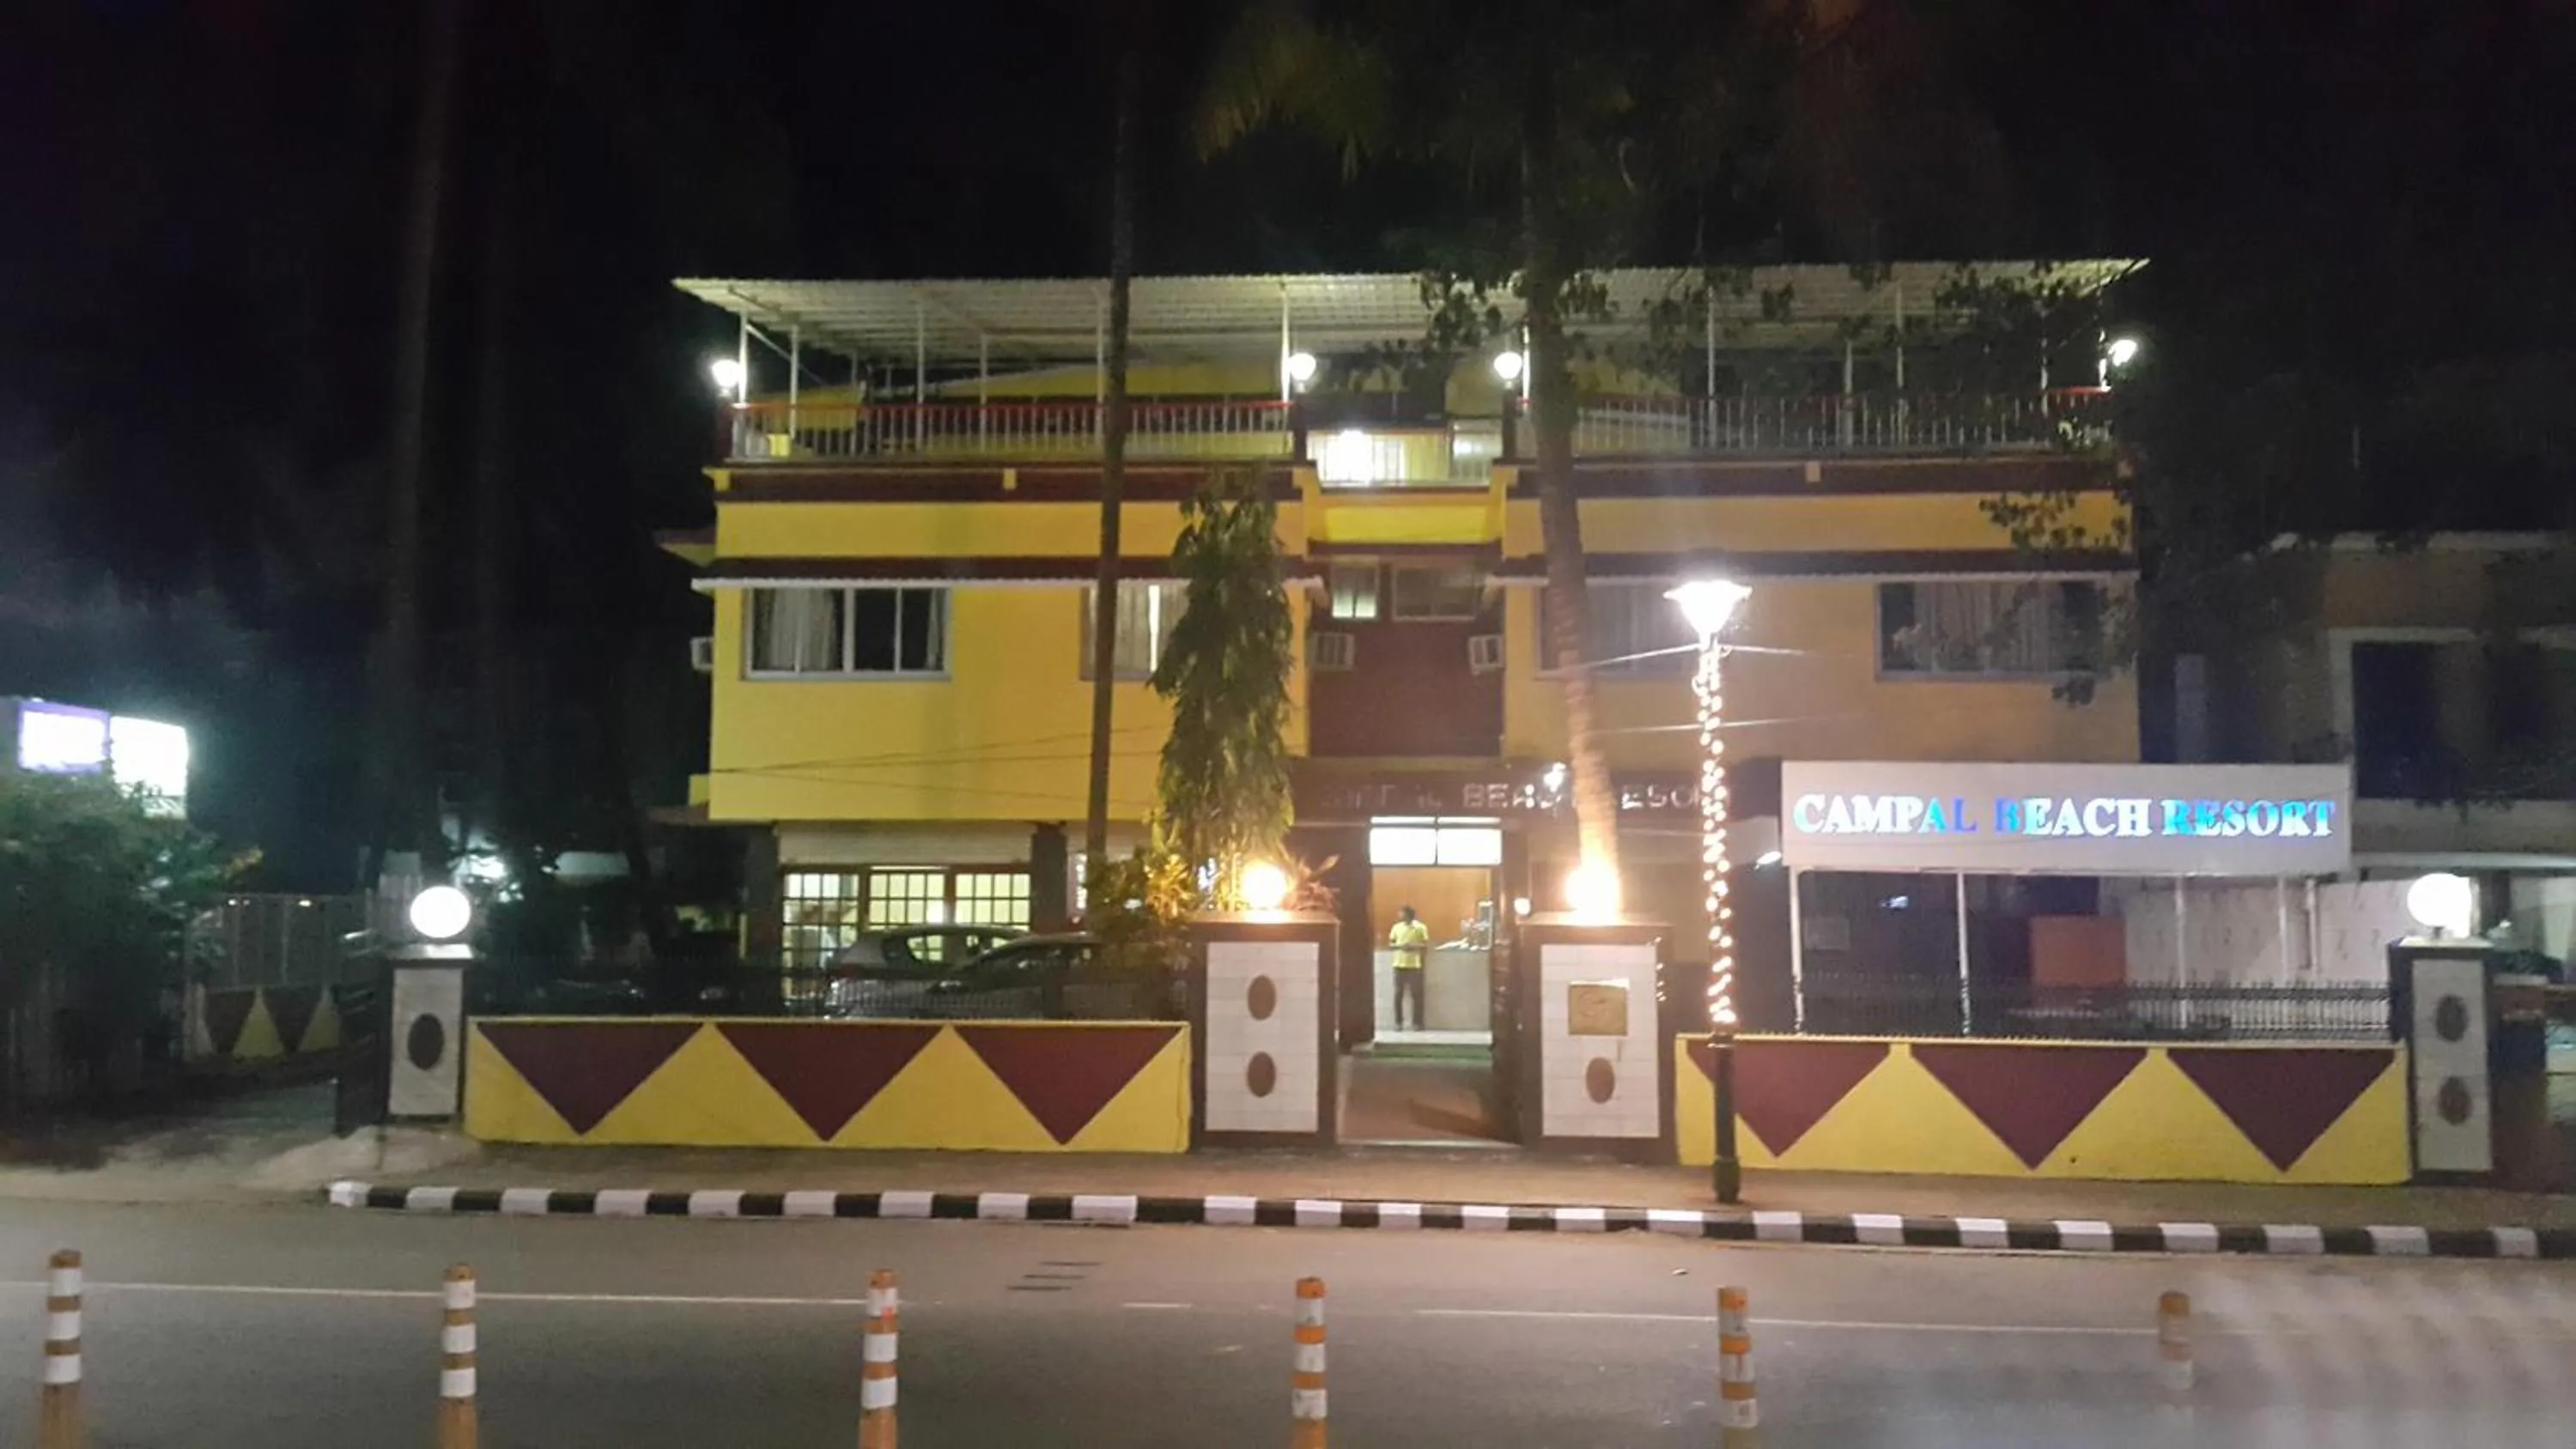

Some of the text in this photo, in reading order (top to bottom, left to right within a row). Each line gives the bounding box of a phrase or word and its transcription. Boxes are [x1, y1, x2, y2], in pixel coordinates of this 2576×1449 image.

[1794, 793, 2336, 837] CAMPAL BEACH RESORT
